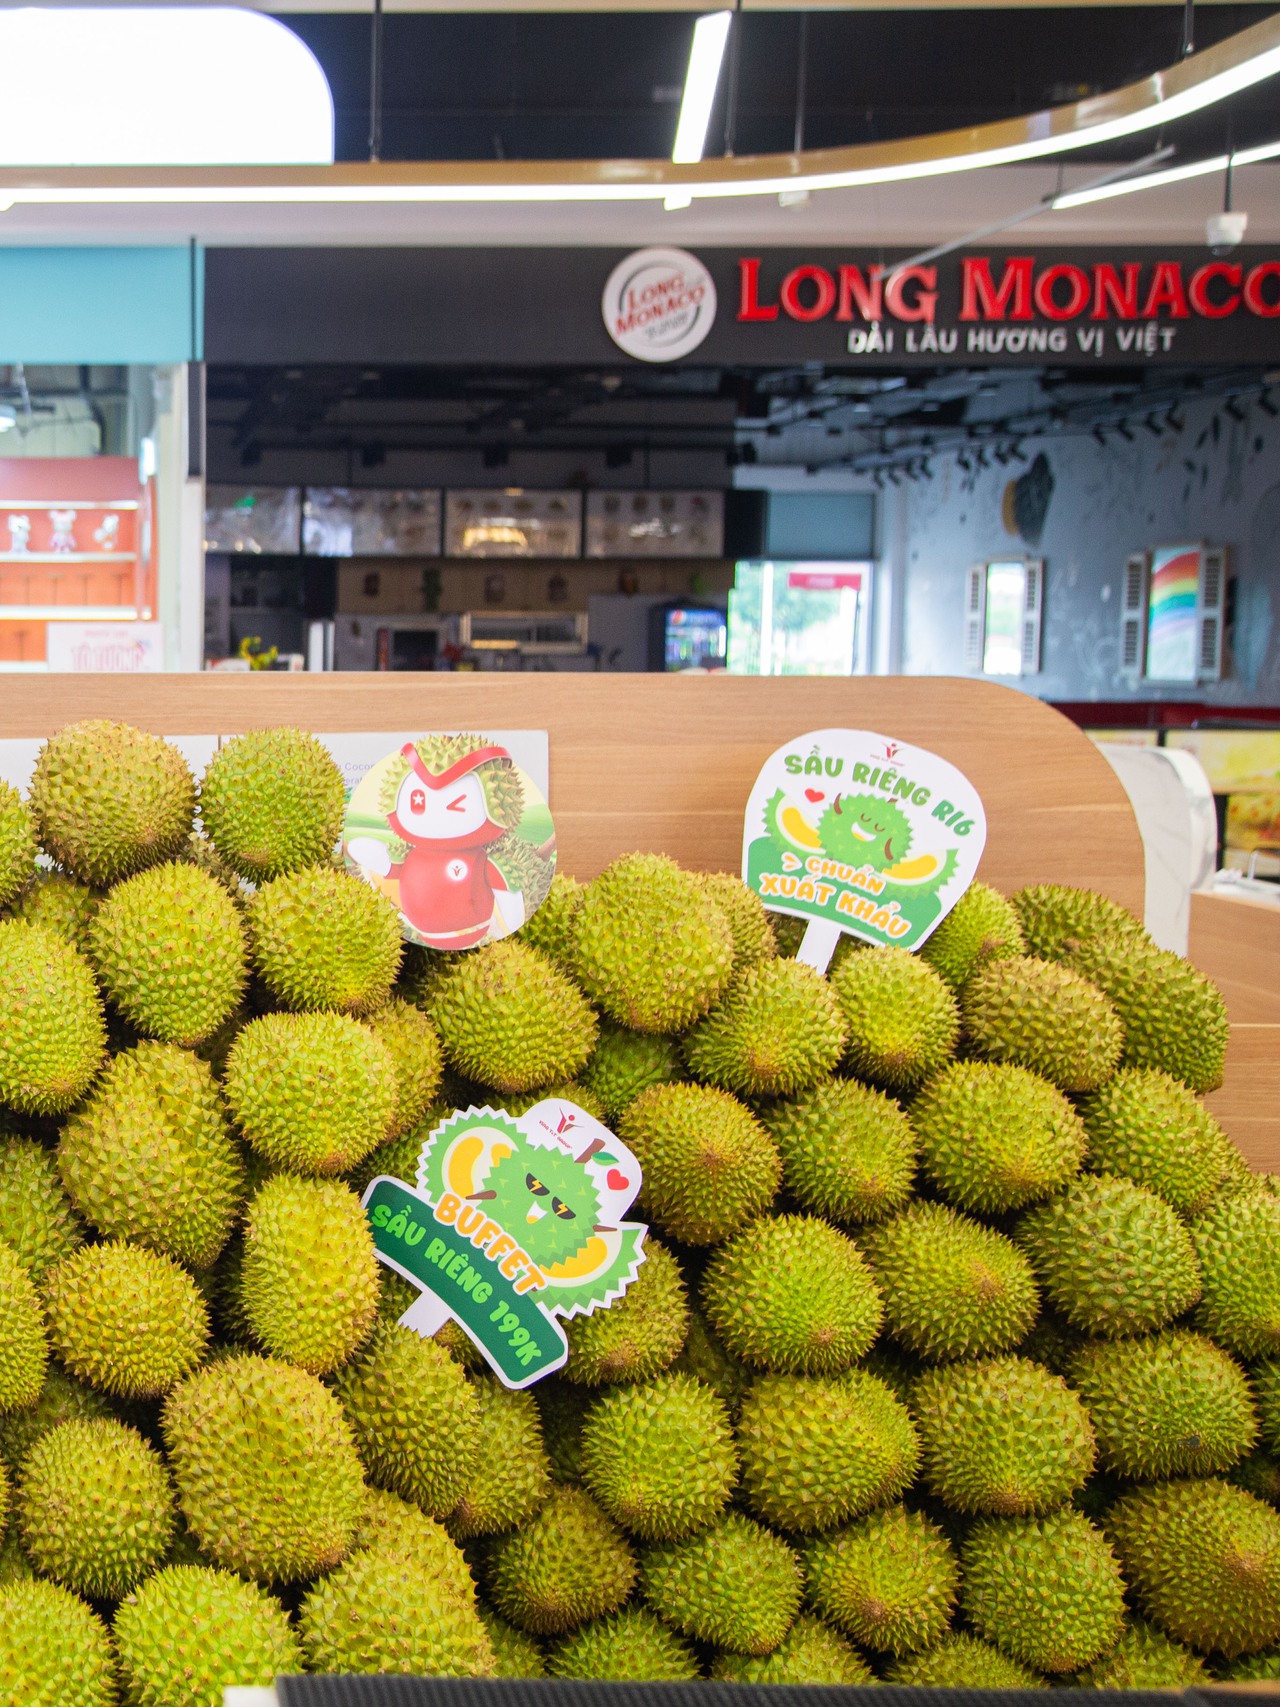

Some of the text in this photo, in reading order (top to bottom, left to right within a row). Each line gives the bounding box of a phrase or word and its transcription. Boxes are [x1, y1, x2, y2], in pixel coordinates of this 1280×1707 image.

[615, 285, 705, 336] MONACO
[627, 272, 684, 311] LONG
[736, 256, 1280, 324] LONG MONACO
[1116, 320, 1177, 357] VIỆT
[784, 745, 844, 777] SẦU
[852, 762, 932, 806] RIÊNG
[761, 872, 910, 937] XUẤT KHẨU
[806, 856, 885, 895] CHUẨN
[434, 1194, 547, 1295] BUFFET
[371, 1204, 543, 1367] SẦU RIÊNG 199K
